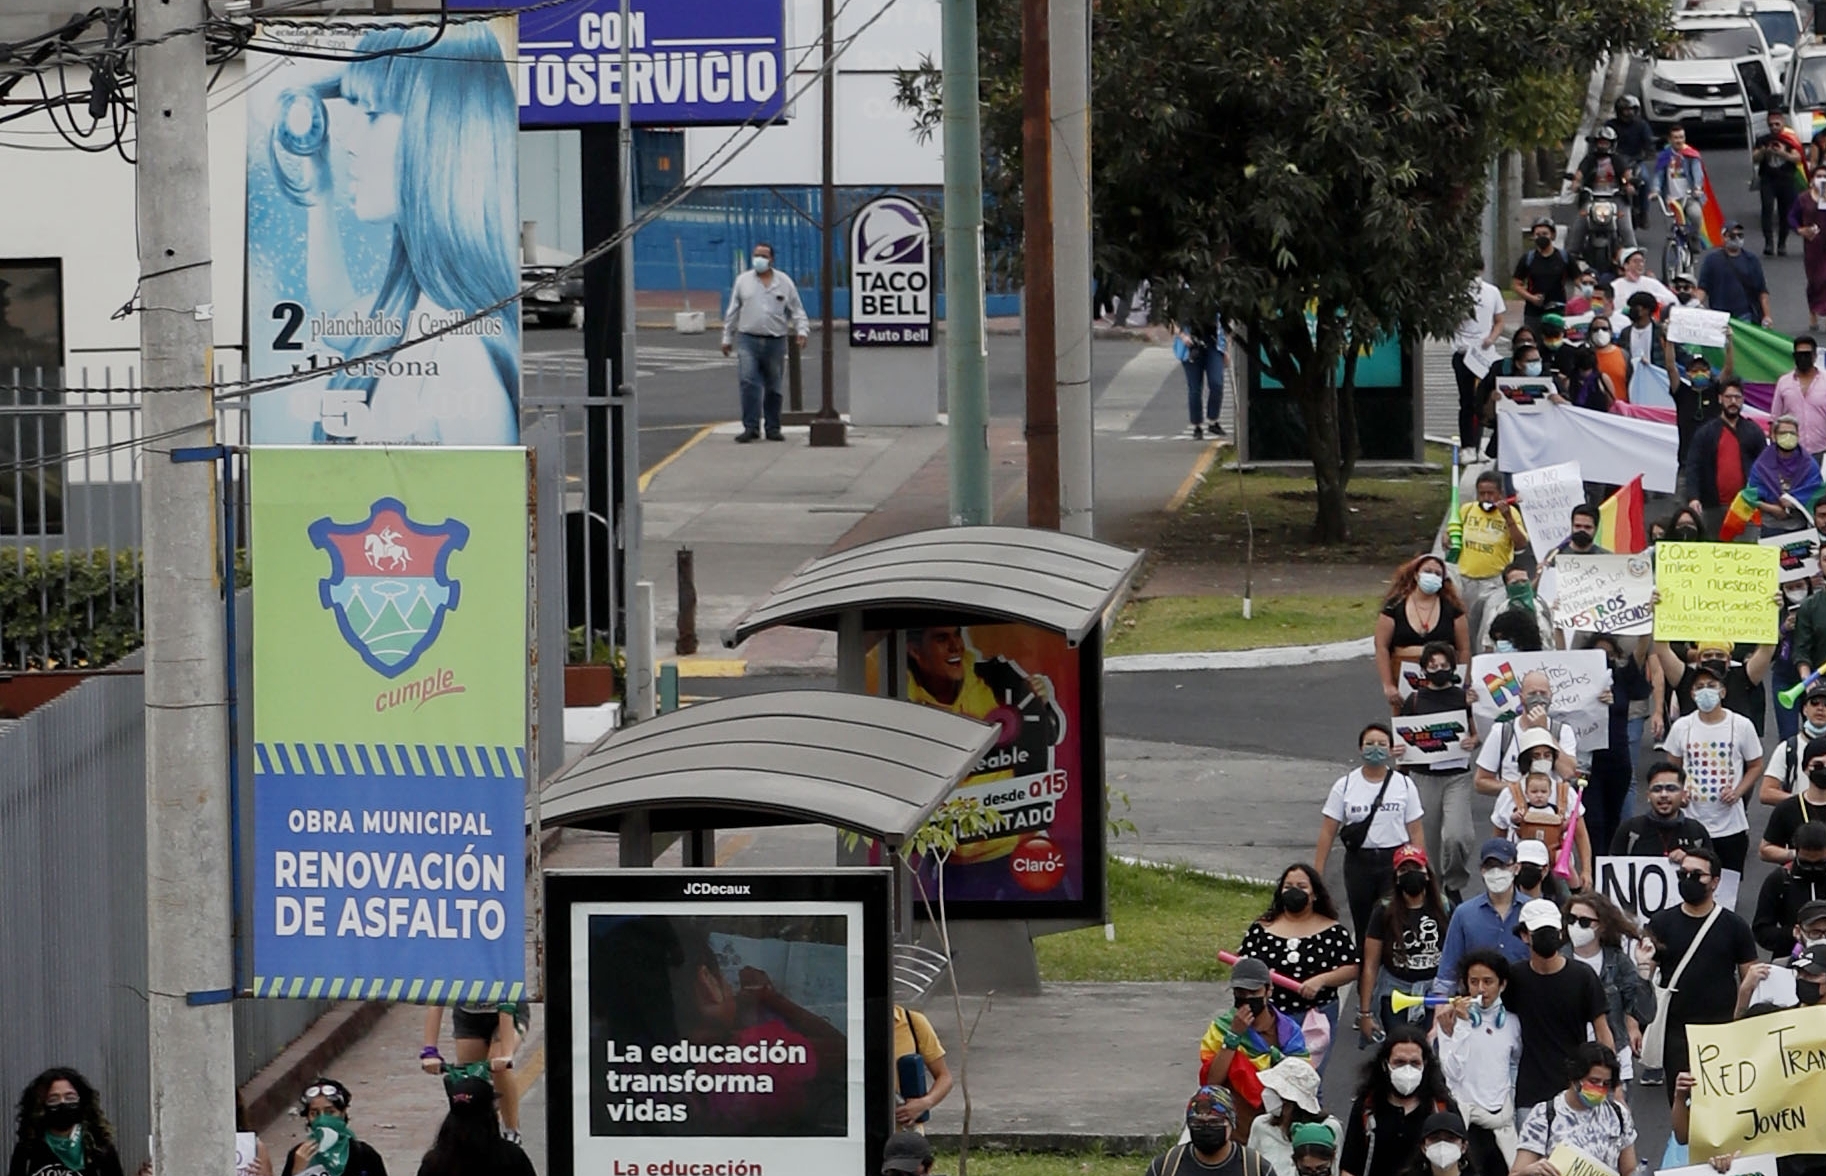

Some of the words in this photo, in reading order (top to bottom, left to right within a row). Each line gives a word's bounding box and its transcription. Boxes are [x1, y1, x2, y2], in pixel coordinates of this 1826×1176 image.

[578, 12, 646, 50] CON
[856, 271, 928, 292] TACO
[861, 295, 928, 316] BELL
[271, 302, 305, 350] 2
[311, 311, 402, 341] planchados
[418, 309, 502, 341] Cepillados
[867, 328, 899, 342] Auto
[903, 328, 930, 342] Bell
[326, 356, 440, 377] Persona
[1737, 564, 1775, 578] tienen
[1553, 594, 1627, 629] NUESTROS
[376, 668, 454, 713] cumple
[982, 788, 1026, 808] desde
[1029, 771, 1068, 798] Q15
[288, 809, 354, 834] OBRA
[362, 810, 492, 836] MUNICIPAL
[275, 844, 505, 892] RENOVACIÓN
[1012, 851, 1060, 873] Claro
[683, 882, 751, 896] JCDecaux
[1602, 862, 1668, 918] NO
[275, 896, 326, 938] DE
[337, 897, 506, 941] ASFALTO
[607, 1040, 643, 1064] La
[651, 1039, 807, 1064] educación
[606, 1069, 774, 1094] transforma
[1697, 1044, 1757, 1098] RED
[607, 1098, 687, 1122] vidas
[1737, 1105, 1807, 1141] JOVEN
[613, 1160, 641, 1176] La
[646, 1159, 763, 1176] educación
